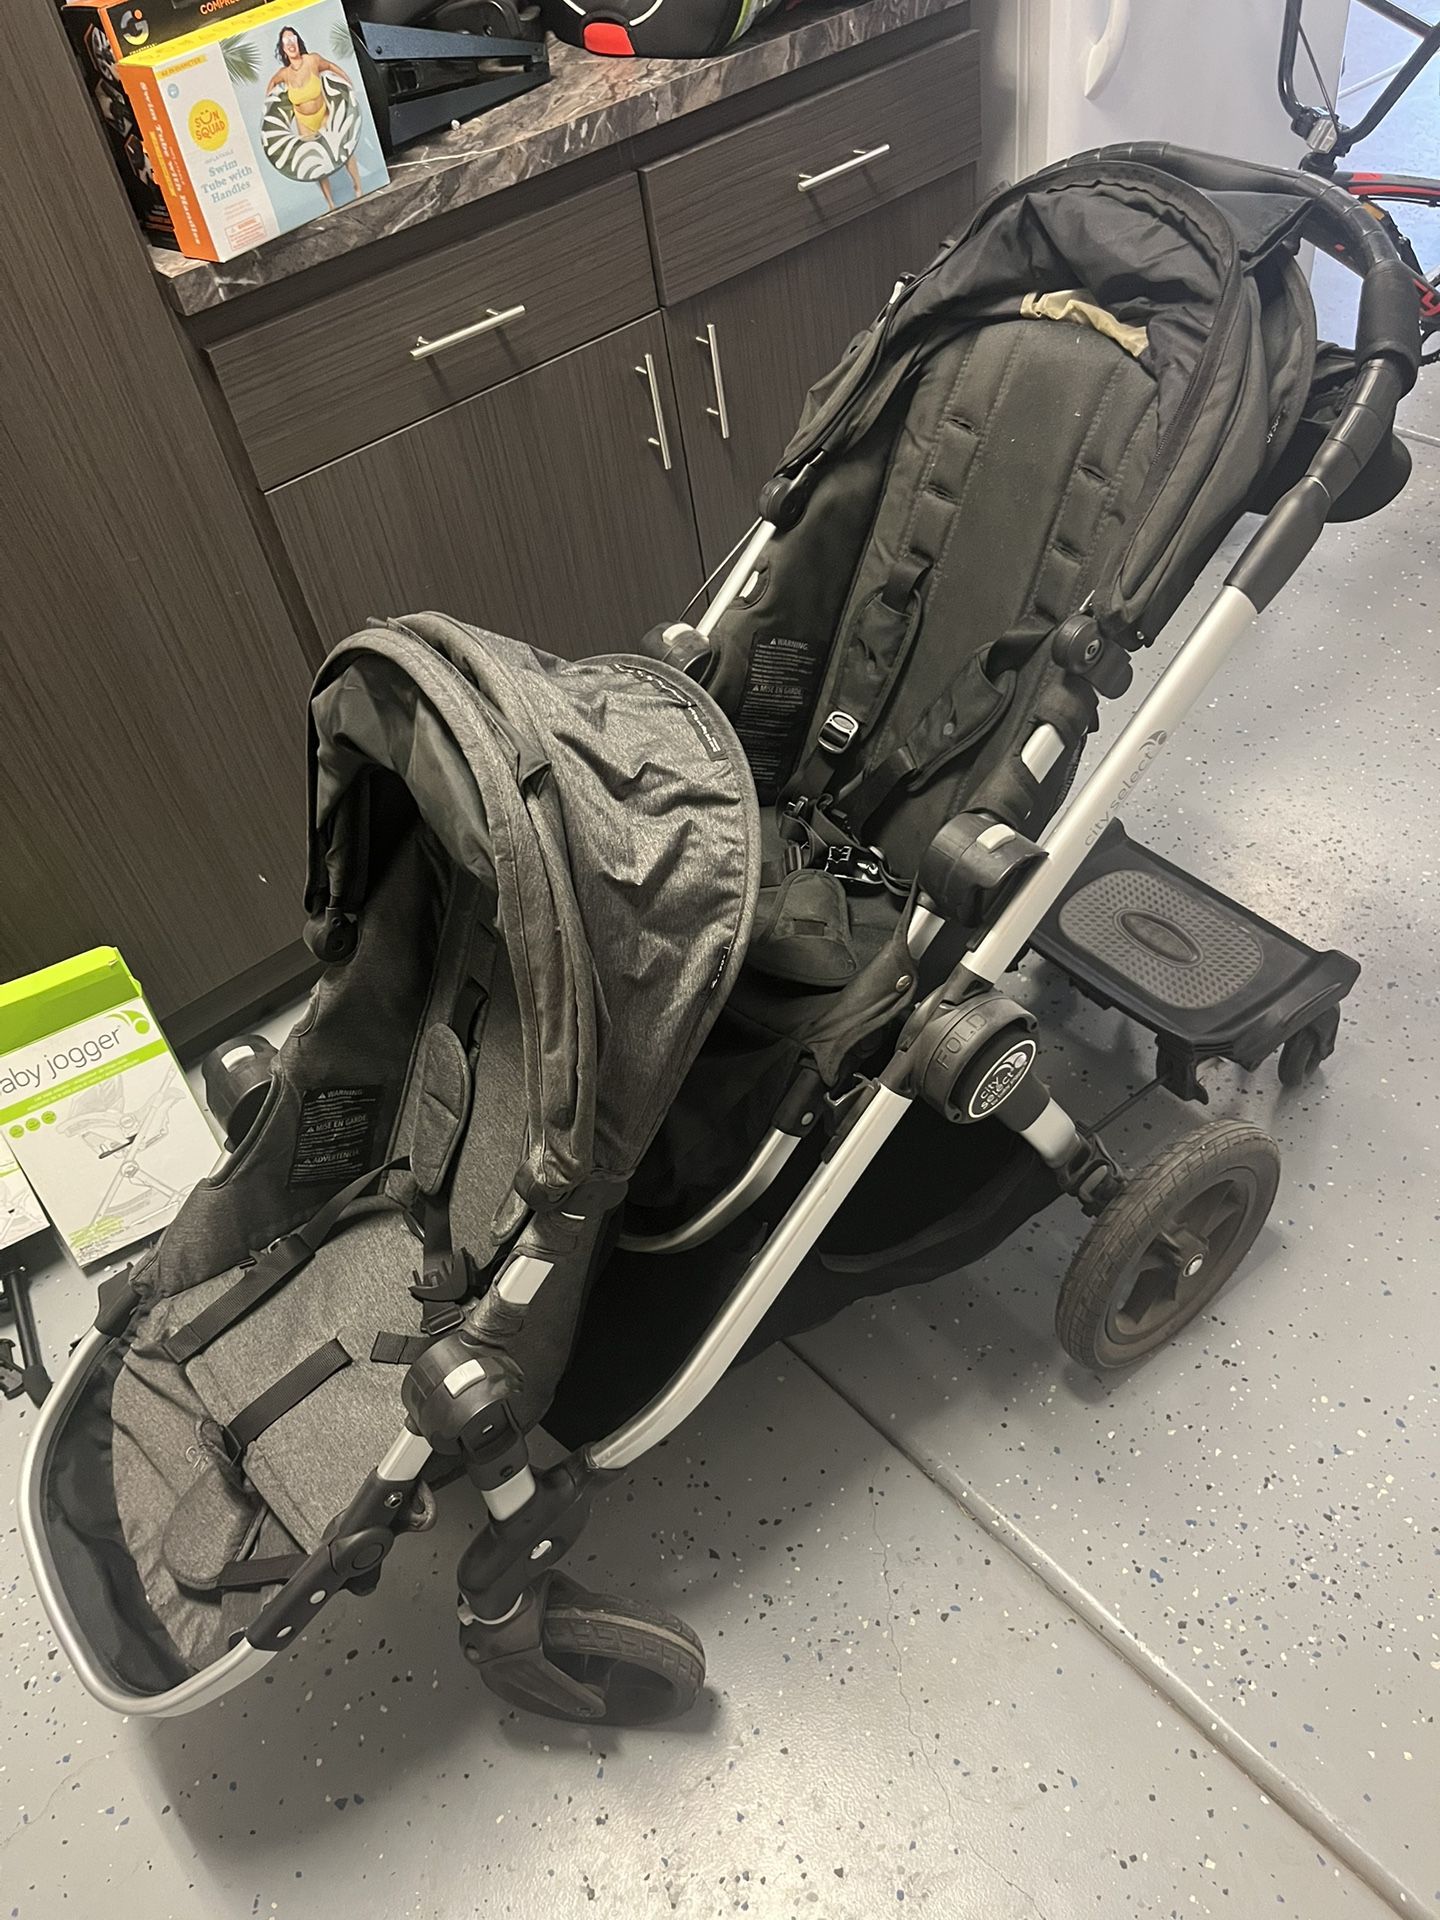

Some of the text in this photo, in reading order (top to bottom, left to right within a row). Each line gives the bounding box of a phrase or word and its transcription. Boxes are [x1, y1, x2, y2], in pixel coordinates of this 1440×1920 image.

[195, 121, 226, 141] SQUAD
[201, 166, 253, 194] Tube with
[208, 159, 238, 177] Swim
[155, 124, 170, 159] Tube
[167, 160, 182, 192] with
[179, 194, 201, 246] Handles
[210, 180, 251, 204] Handles
[777, 638, 809, 650] WARNING
[1085, 751, 1153, 846] city select
[935, 1012, 988, 1071] FOLD
[0, 1064, 41, 1095] aby
[44, 1028, 121, 1079] jogger
[327, 1089, 362, 1097] WARNING
[979, 1076, 999, 1099] city
[980, 1072, 1014, 1110] select
